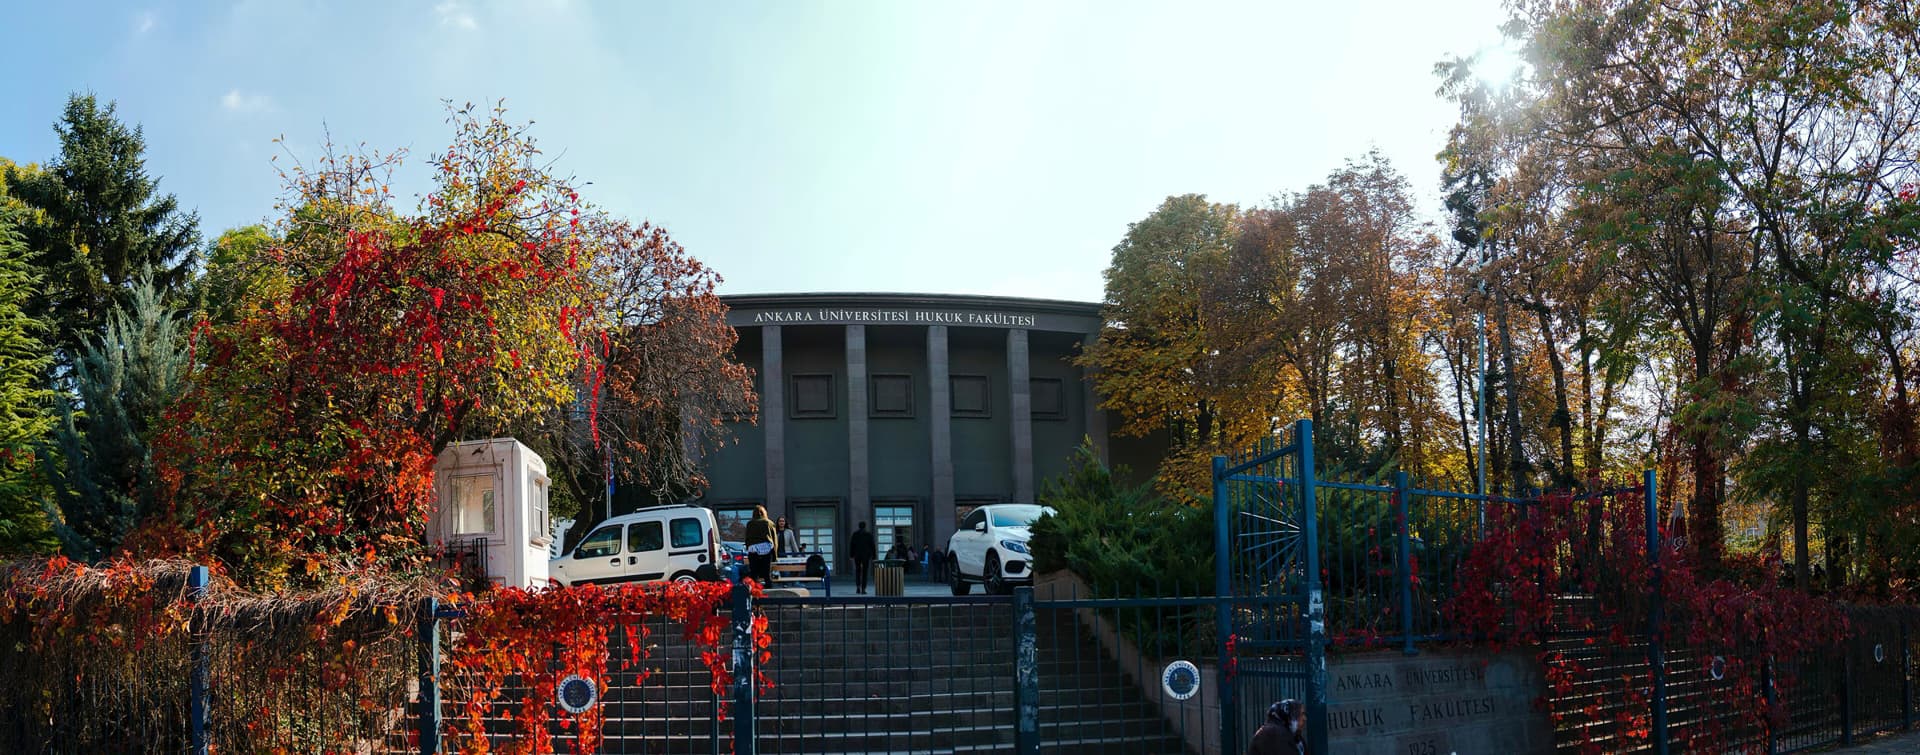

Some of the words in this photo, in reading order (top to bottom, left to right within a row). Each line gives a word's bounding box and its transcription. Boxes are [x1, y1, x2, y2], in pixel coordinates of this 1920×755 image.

[754, 311, 813, 322] ANKARA
[819, 309, 909, 321] ÜNİVERSİTESİ
[915, 311, 962, 323] HUKUK
[969, 312, 1035, 326] FAKÜLTESİ
[1336, 673, 1392, 690] ANKARA
[1327, 707, 1384, 729] HUKUK
